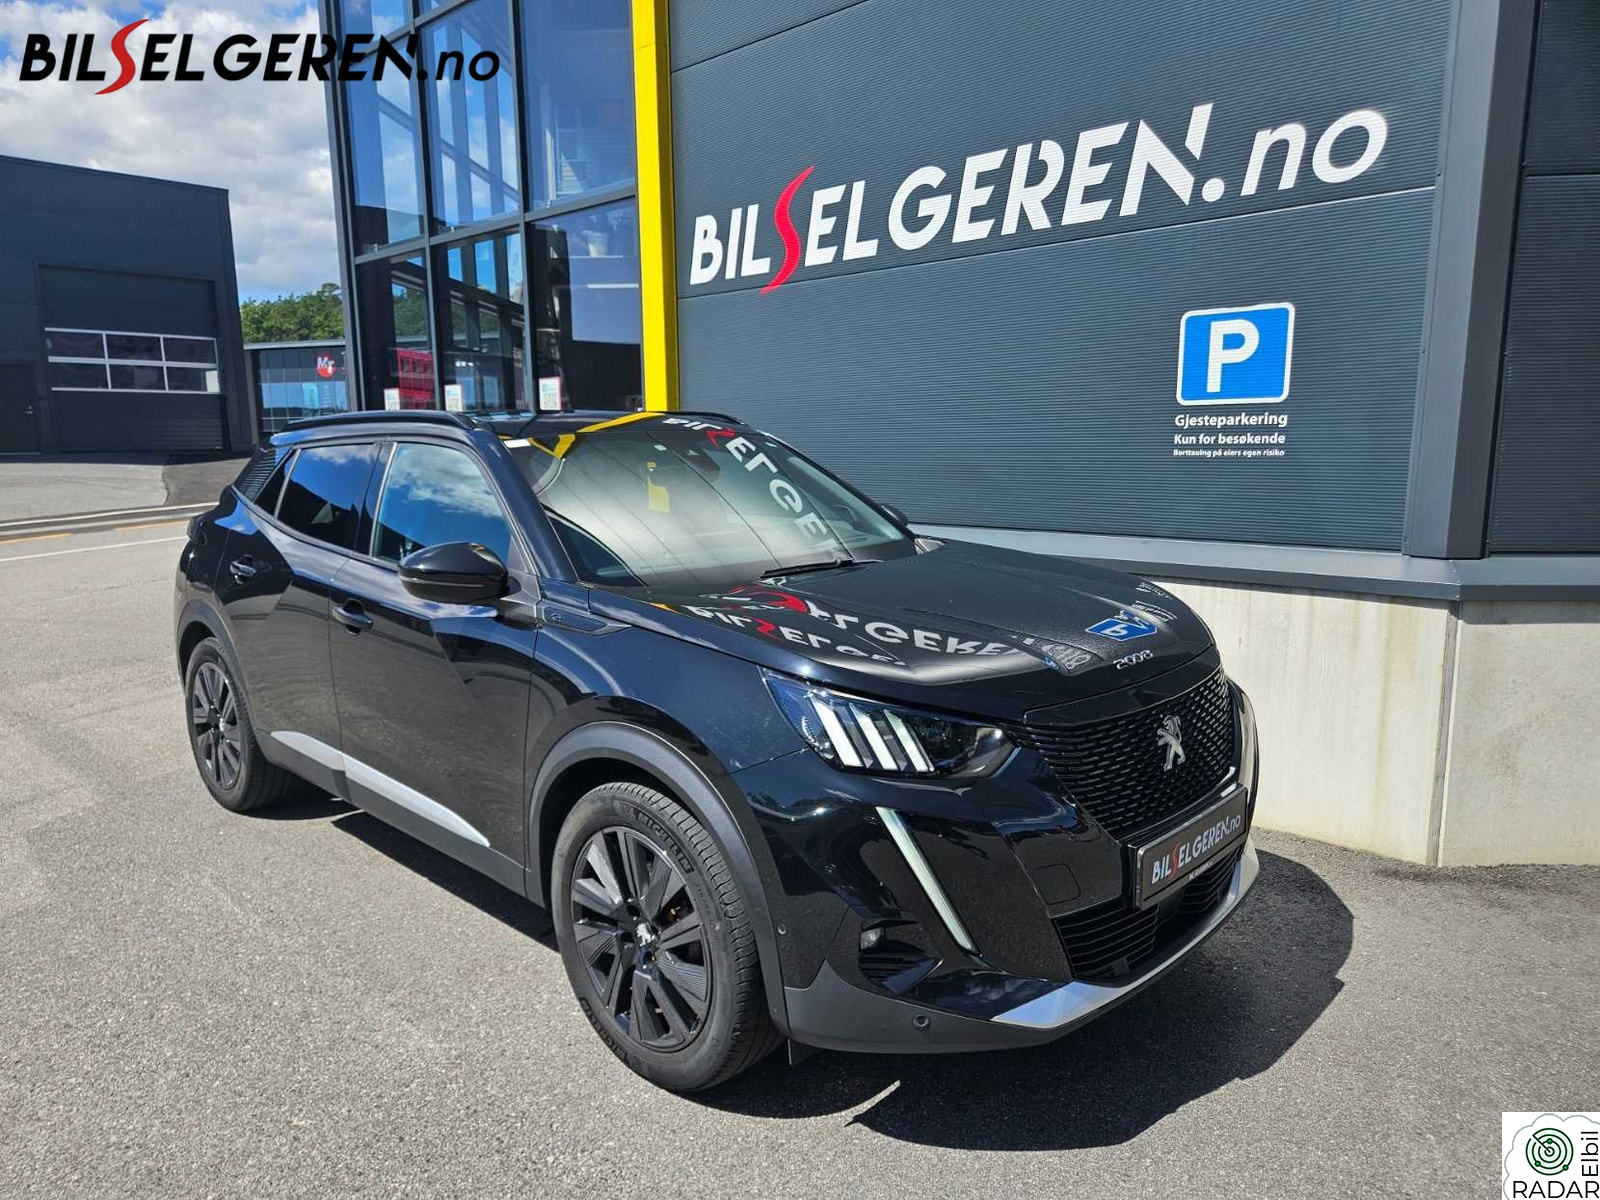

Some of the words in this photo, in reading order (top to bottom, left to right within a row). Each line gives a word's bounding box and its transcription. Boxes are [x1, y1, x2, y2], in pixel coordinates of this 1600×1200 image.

[689, 103, 1389, 294] BILSELGEREN.no
[1206, 318, 1260, 393] P
[1174, 412, 1289, 429] Gjesteparkering
[1174, 434, 1197, 445] Kun
[1198, 433, 1217, 445] for
[1217, 432, 1286, 445] besøkende
[1212, 448, 1223, 458] på
[1242, 450, 1262, 458] egen
[1112, 649, 1154, 670] 2008
[1151, 814, 1241, 885] BILSELGEREN.no
